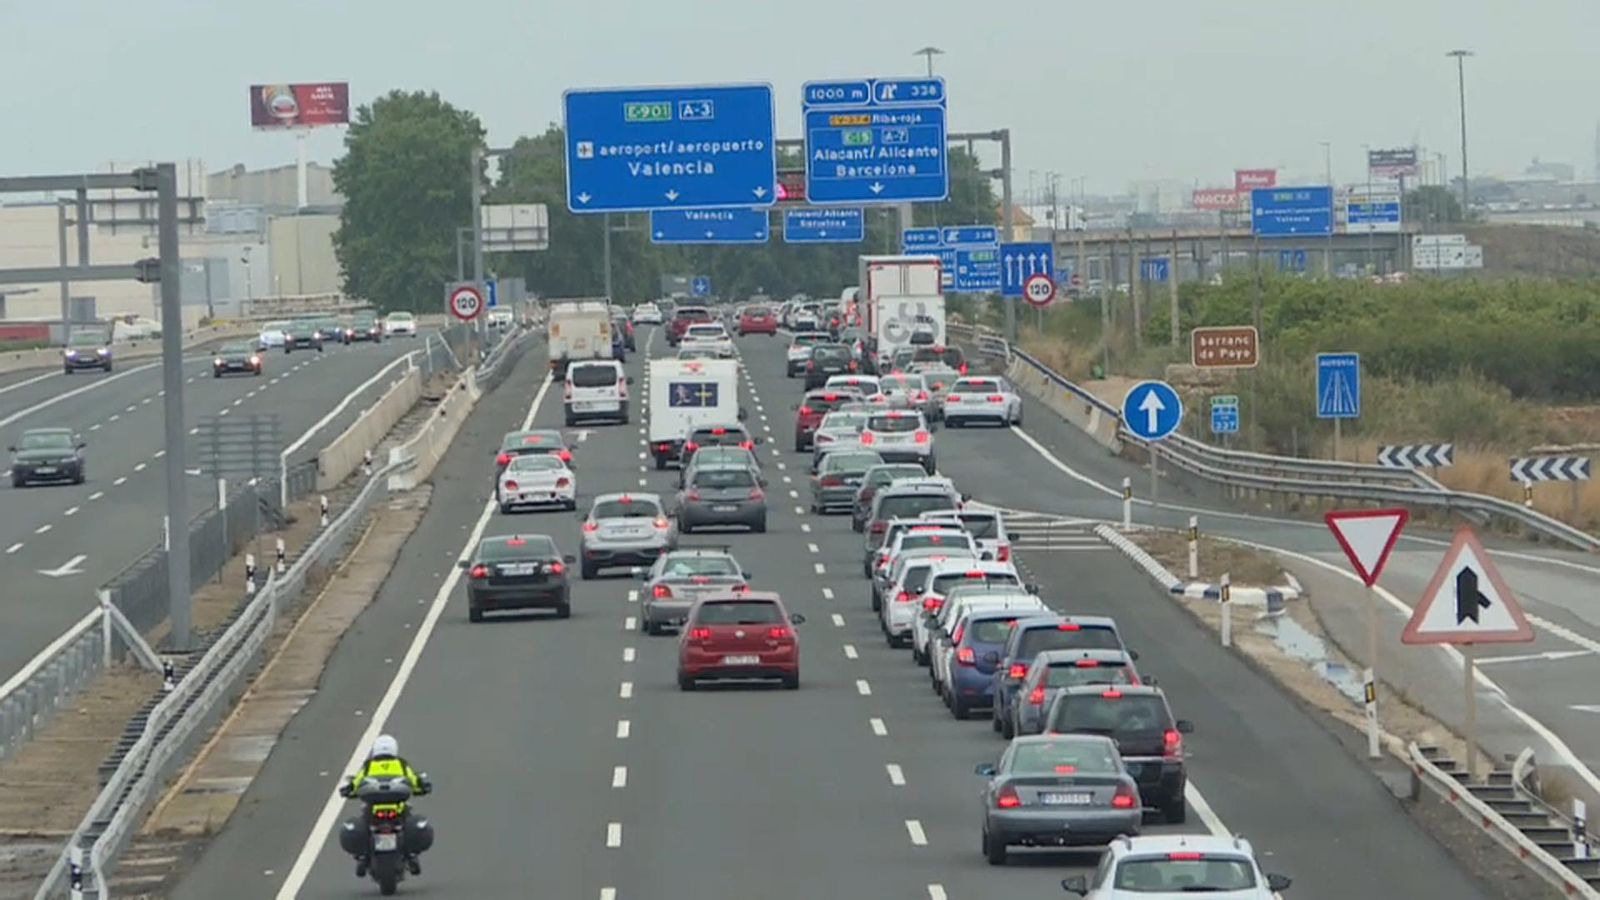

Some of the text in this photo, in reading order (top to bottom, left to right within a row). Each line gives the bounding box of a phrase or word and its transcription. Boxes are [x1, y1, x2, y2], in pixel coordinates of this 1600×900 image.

[811, 88, 863, 100] 1000 m
[628, 104, 669, 118] E-901
[682, 103, 711, 117] A-3
[600, 138, 764, 157] aeroport/ aeropuerto
[879, 145, 938, 158] Alicante
[628, 160, 714, 177] Valencia
[836, 163, 917, 177] Barcelona
[685, 210, 734, 221] Valencia
[1030, 283, 1050, 295] 120
[456, 297, 476, 309] 120
